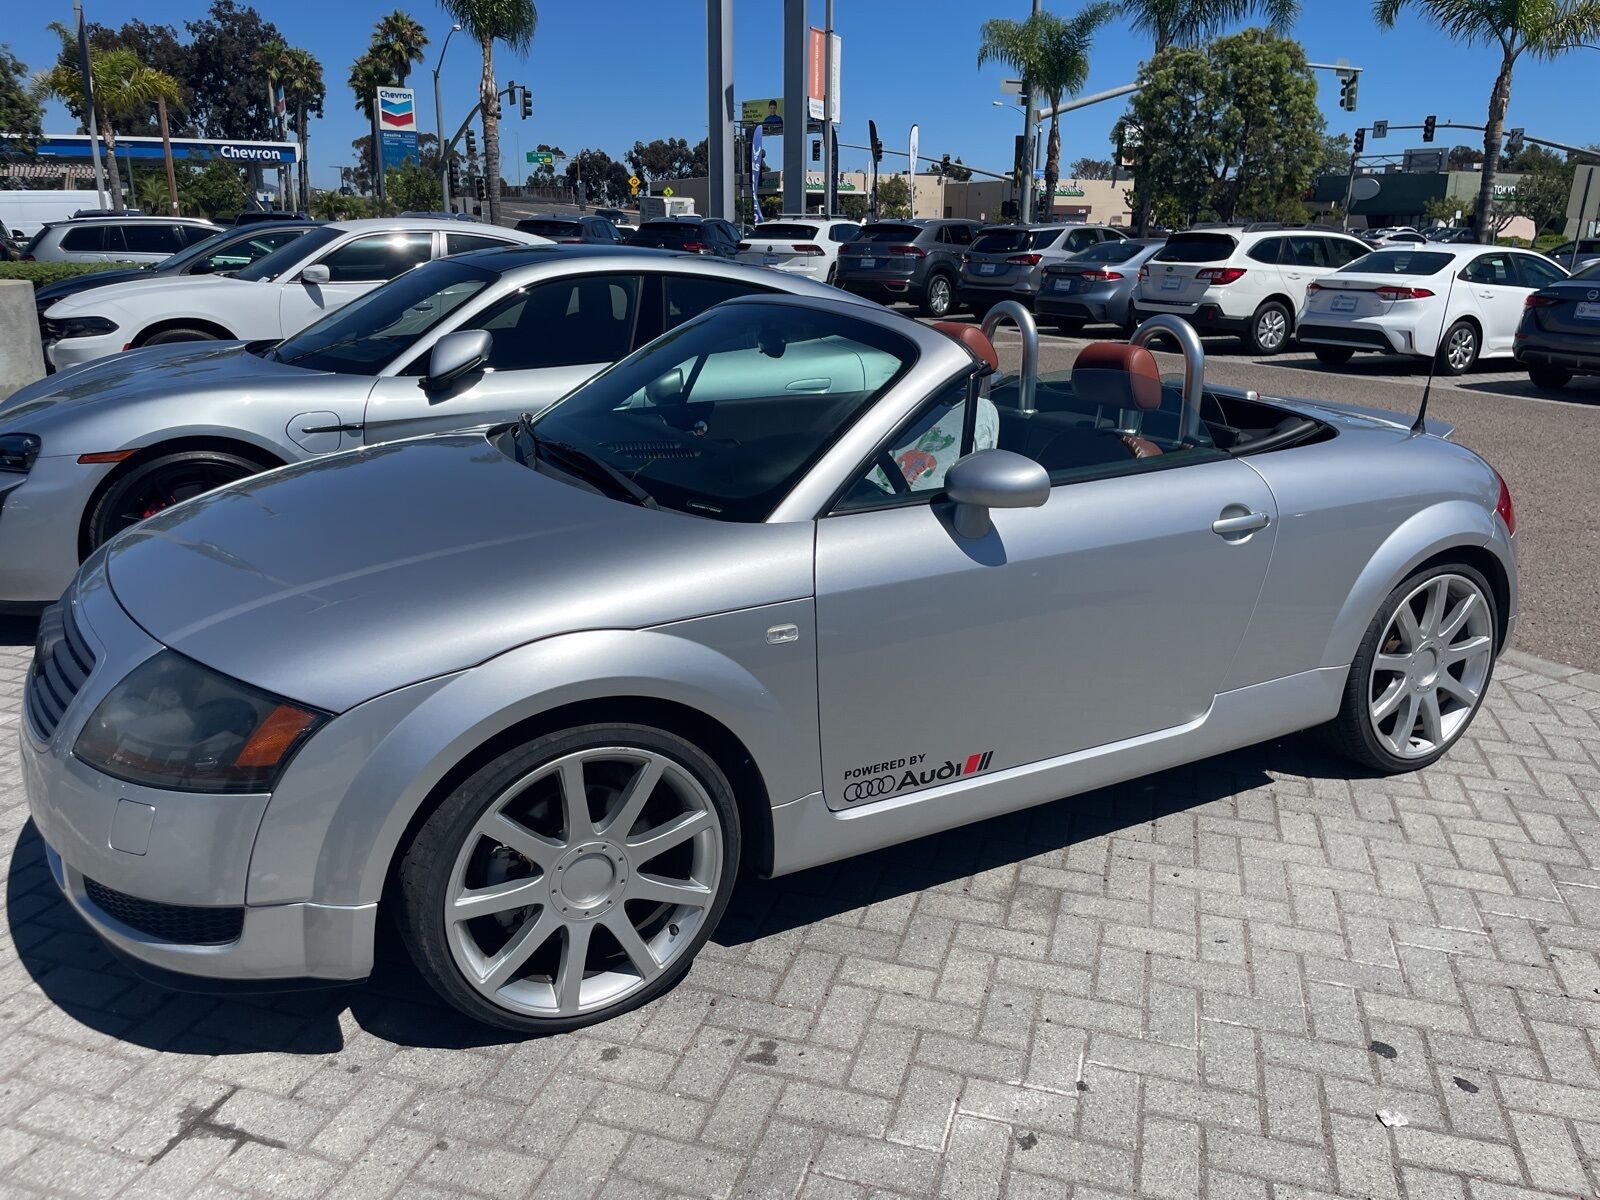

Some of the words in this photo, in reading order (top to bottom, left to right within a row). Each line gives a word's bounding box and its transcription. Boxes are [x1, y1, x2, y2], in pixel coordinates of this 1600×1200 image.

[379, 90, 412, 99] Chevron
[220, 145, 281, 160] Chevron
[1494, 185, 1516, 195] TOKYO
[844, 758, 906, 780] POWERED
[909, 753, 927, 766] BY
[895, 761, 962, 792] Audi
